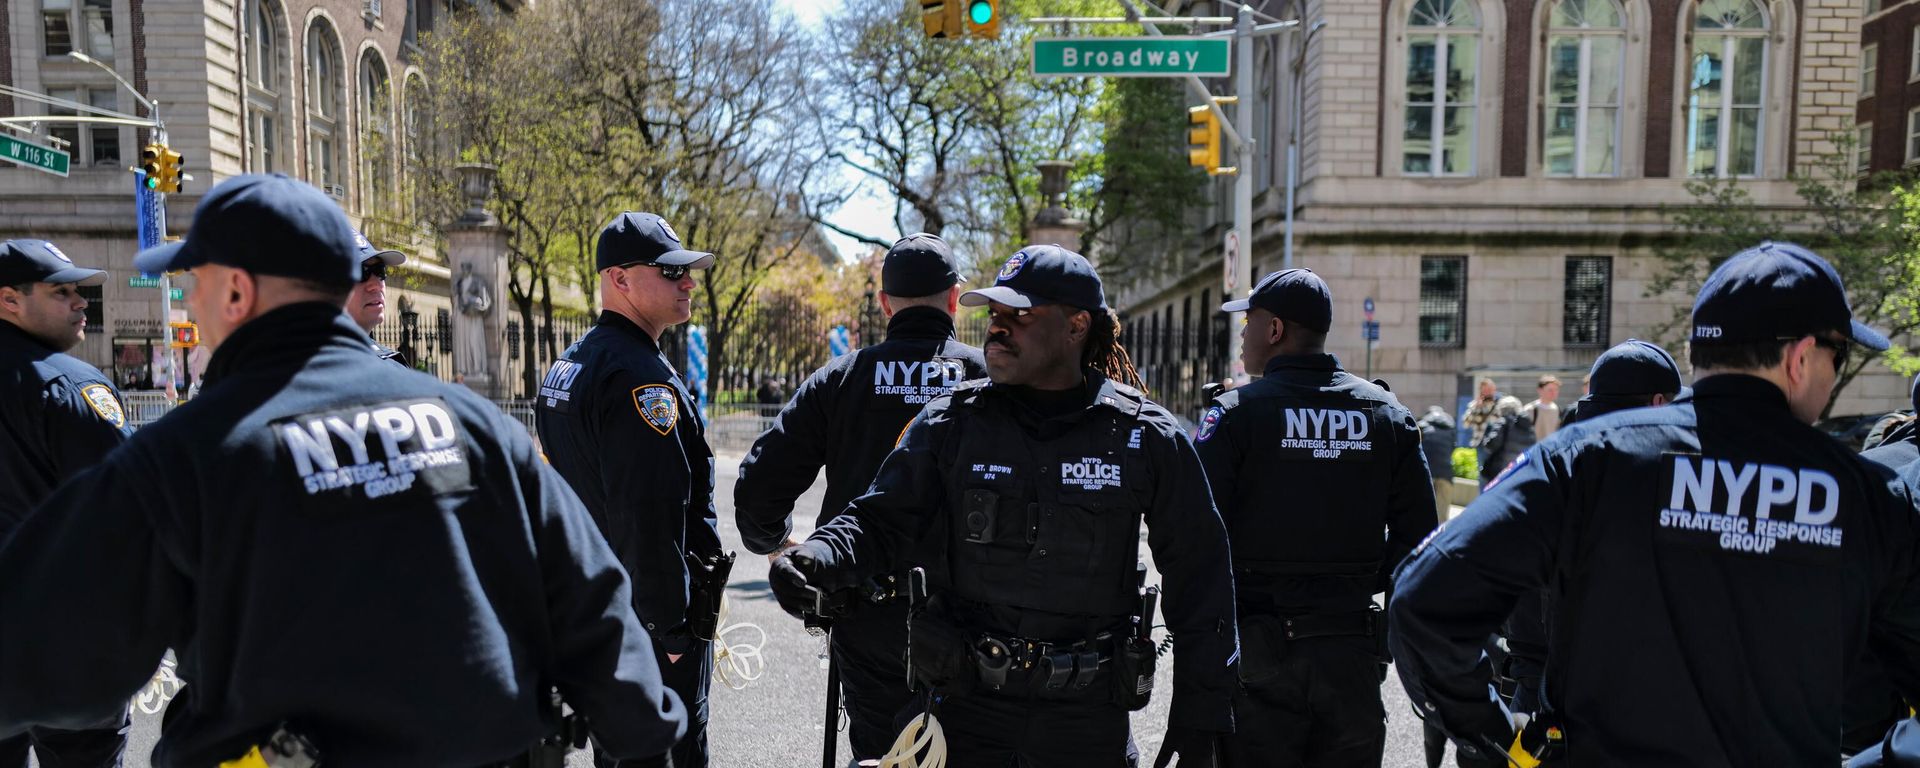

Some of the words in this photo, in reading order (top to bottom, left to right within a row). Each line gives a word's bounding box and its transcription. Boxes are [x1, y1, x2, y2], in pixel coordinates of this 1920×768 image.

[1063, 48, 1199, 70] Broadway
[10, 141, 21, 158] W
[25, 146, 40, 164] 116
[43, 151, 55, 168] St
[543, 359, 583, 390] NYPD
[874, 361, 963, 387] NYPD
[875, 386, 918, 395] STRATEGIC
[920, 387, 954, 396] RESPON
[904, 395, 931, 404] GROUP
[1284, 408, 1369, 440] NYPD
[283, 403, 456, 478] NYPD
[1281, 439, 1327, 449] STRATEGIC
[1329, 441, 1372, 450] RESPONSE
[1313, 449, 1341, 458] GROUP
[304, 461, 387, 494] STRATEGIC
[389, 448, 462, 475] RESPONSE
[972, 464, 986, 472] DET.
[989, 465, 1012, 474] BROWN
[1062, 463, 1121, 480] POLICE
[364, 472, 416, 499] GROUP
[1094, 479, 1121, 487] RESPONSE
[1670, 456, 1840, 525] NYPD
[1659, 509, 1749, 534] STRATEGIC
[1754, 518, 1843, 546] RESPONSE
[1719, 533, 1776, 554] GROUP
